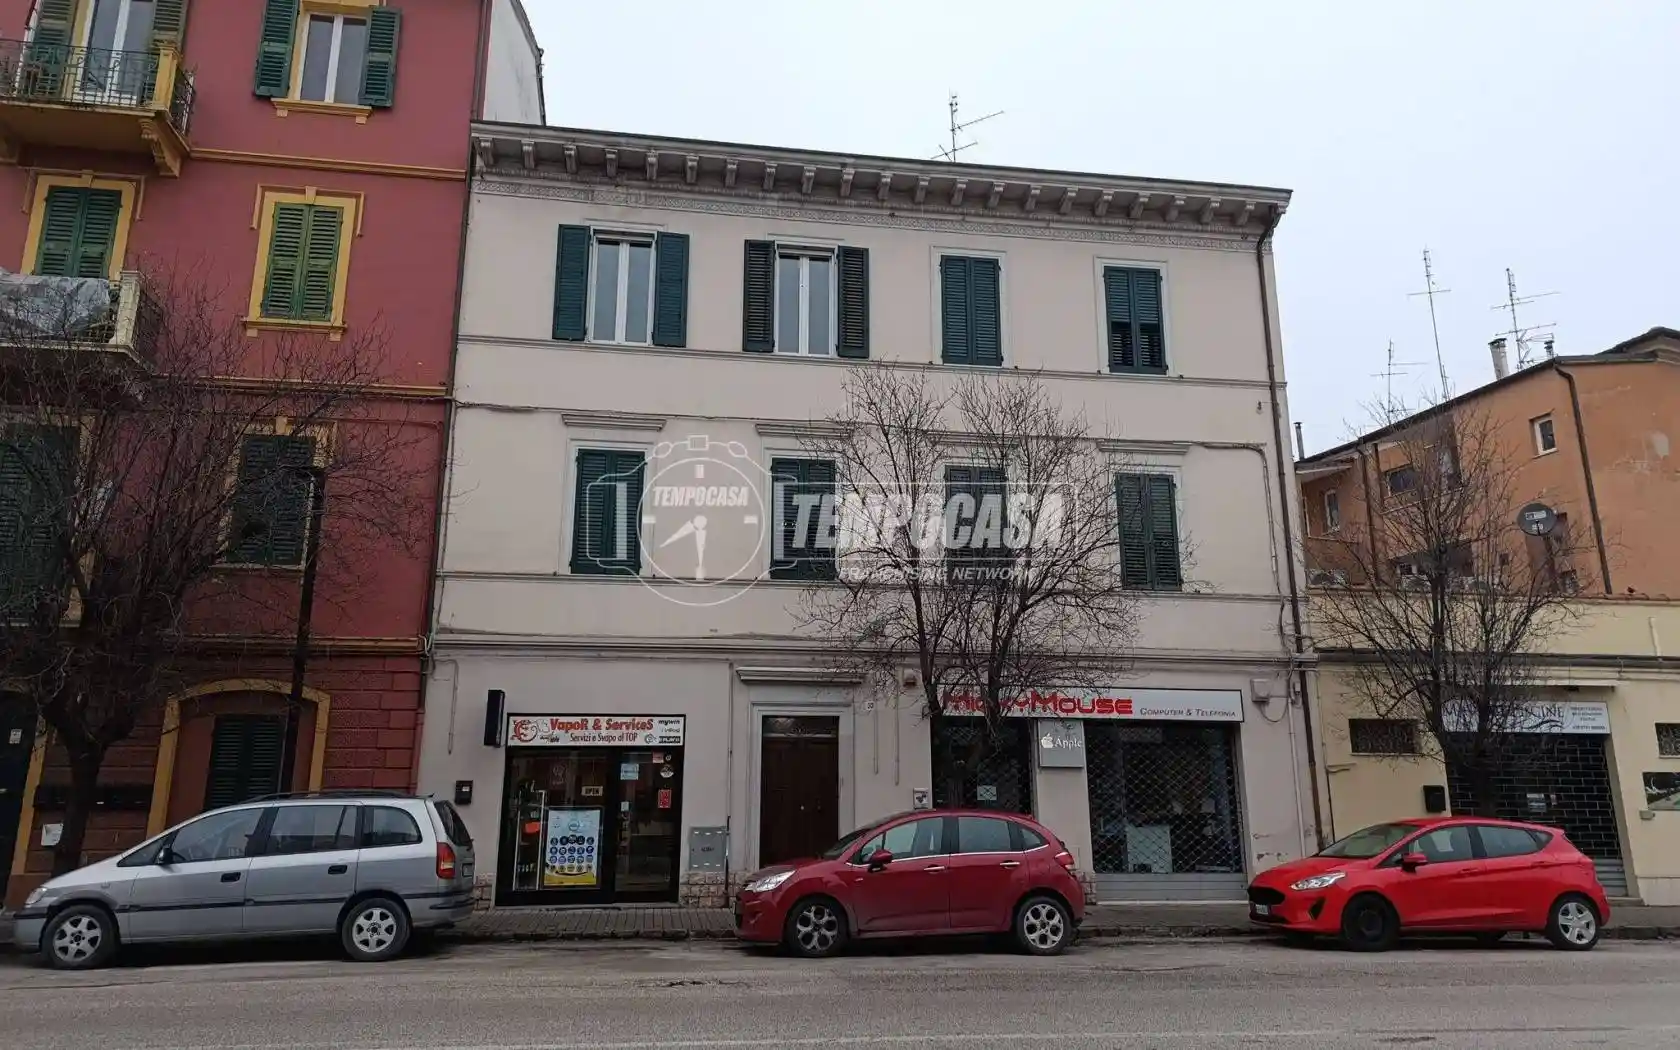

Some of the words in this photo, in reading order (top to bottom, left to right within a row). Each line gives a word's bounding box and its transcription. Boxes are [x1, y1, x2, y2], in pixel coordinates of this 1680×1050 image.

[592, 718, 602, 731] &
[570, 732, 592, 742] Servizi
[624, 732, 638, 742] TOP
[1054, 736, 1083, 750] Apple
